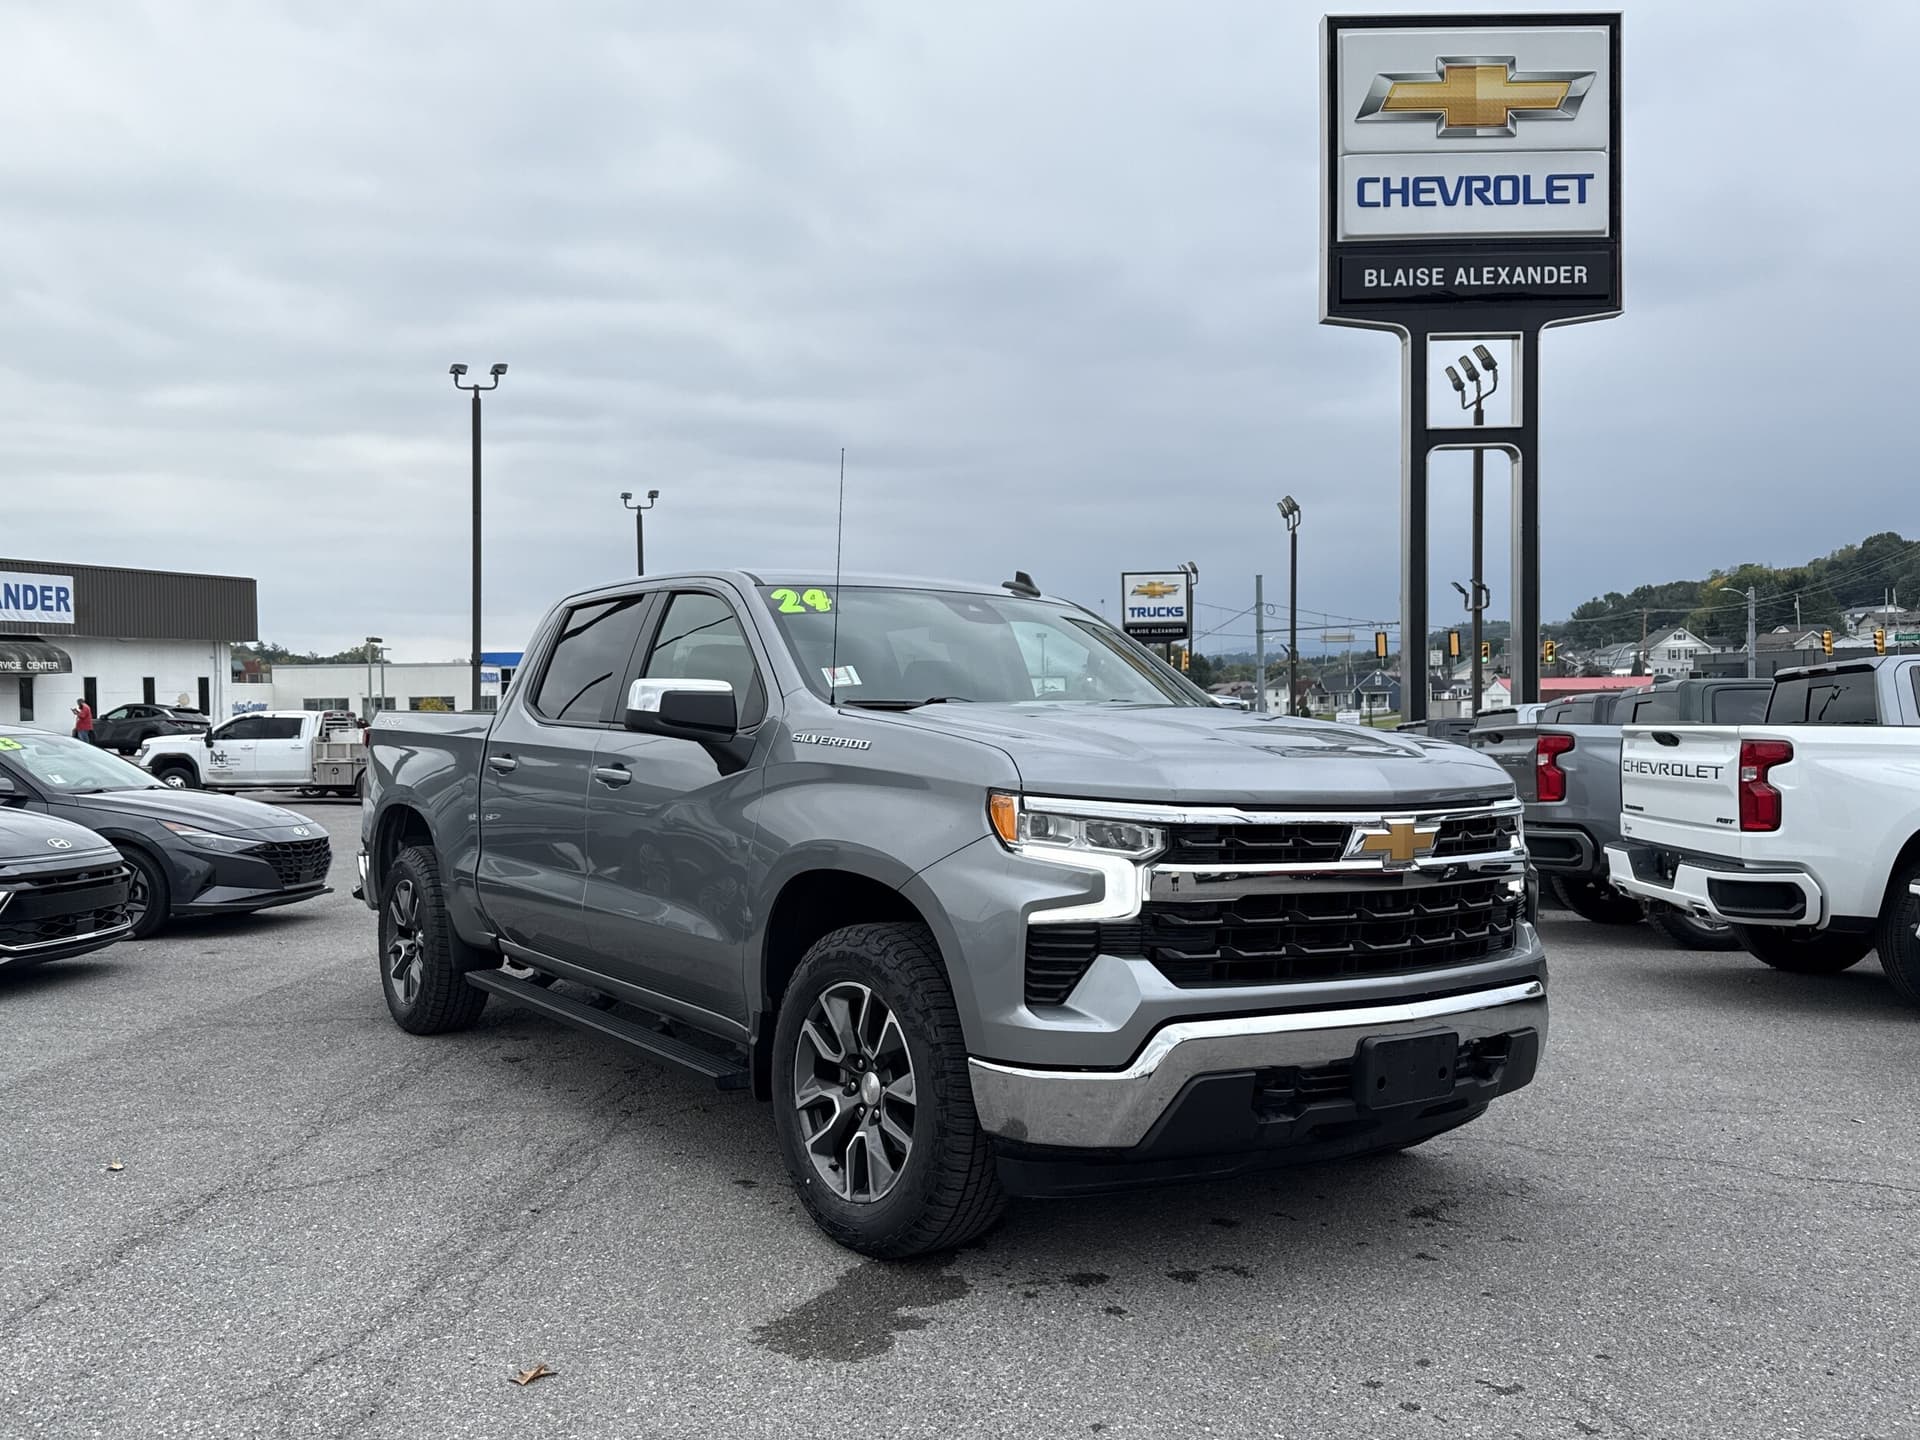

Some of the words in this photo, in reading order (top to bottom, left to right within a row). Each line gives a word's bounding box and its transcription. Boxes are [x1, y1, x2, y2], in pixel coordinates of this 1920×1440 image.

[1356, 173, 1595, 208] CHEVROLET
[1364, 267, 1445, 288] BLAISE
[1454, 265, 1588, 287] ALEXANDER
[0, 583, 71, 613] NDER
[770, 588, 833, 613] 24
[1128, 606, 1184, 618] TRUCKS
[26, 661, 59, 670] CENTER
[792, 732, 872, 751] SILVERADO
[1623, 760, 1724, 779] CHEVROLET
[1716, 817, 1736, 825] RST
